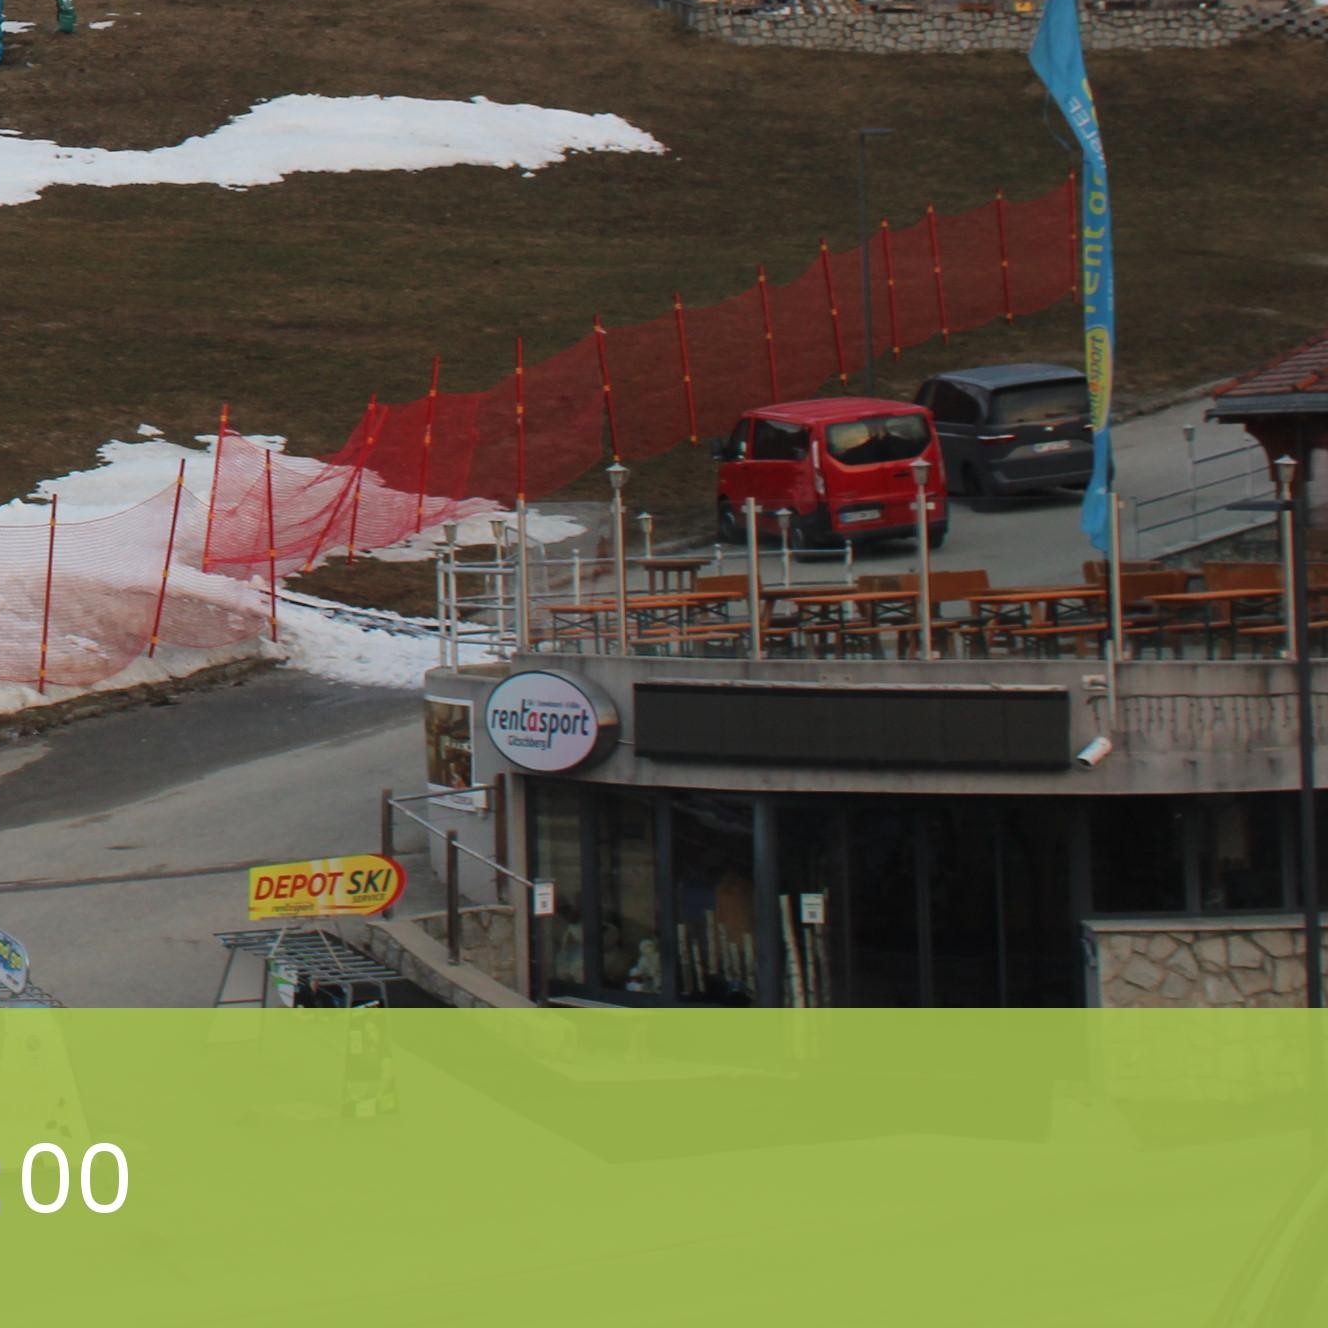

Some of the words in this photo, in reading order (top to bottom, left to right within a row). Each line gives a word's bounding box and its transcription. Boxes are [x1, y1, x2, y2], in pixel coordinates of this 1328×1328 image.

[492, 699, 589, 749] rentasport
[255, 873, 344, 900] DEPOT
[346, 868, 393, 895] SKI
[10, 951, 24, 971] go
